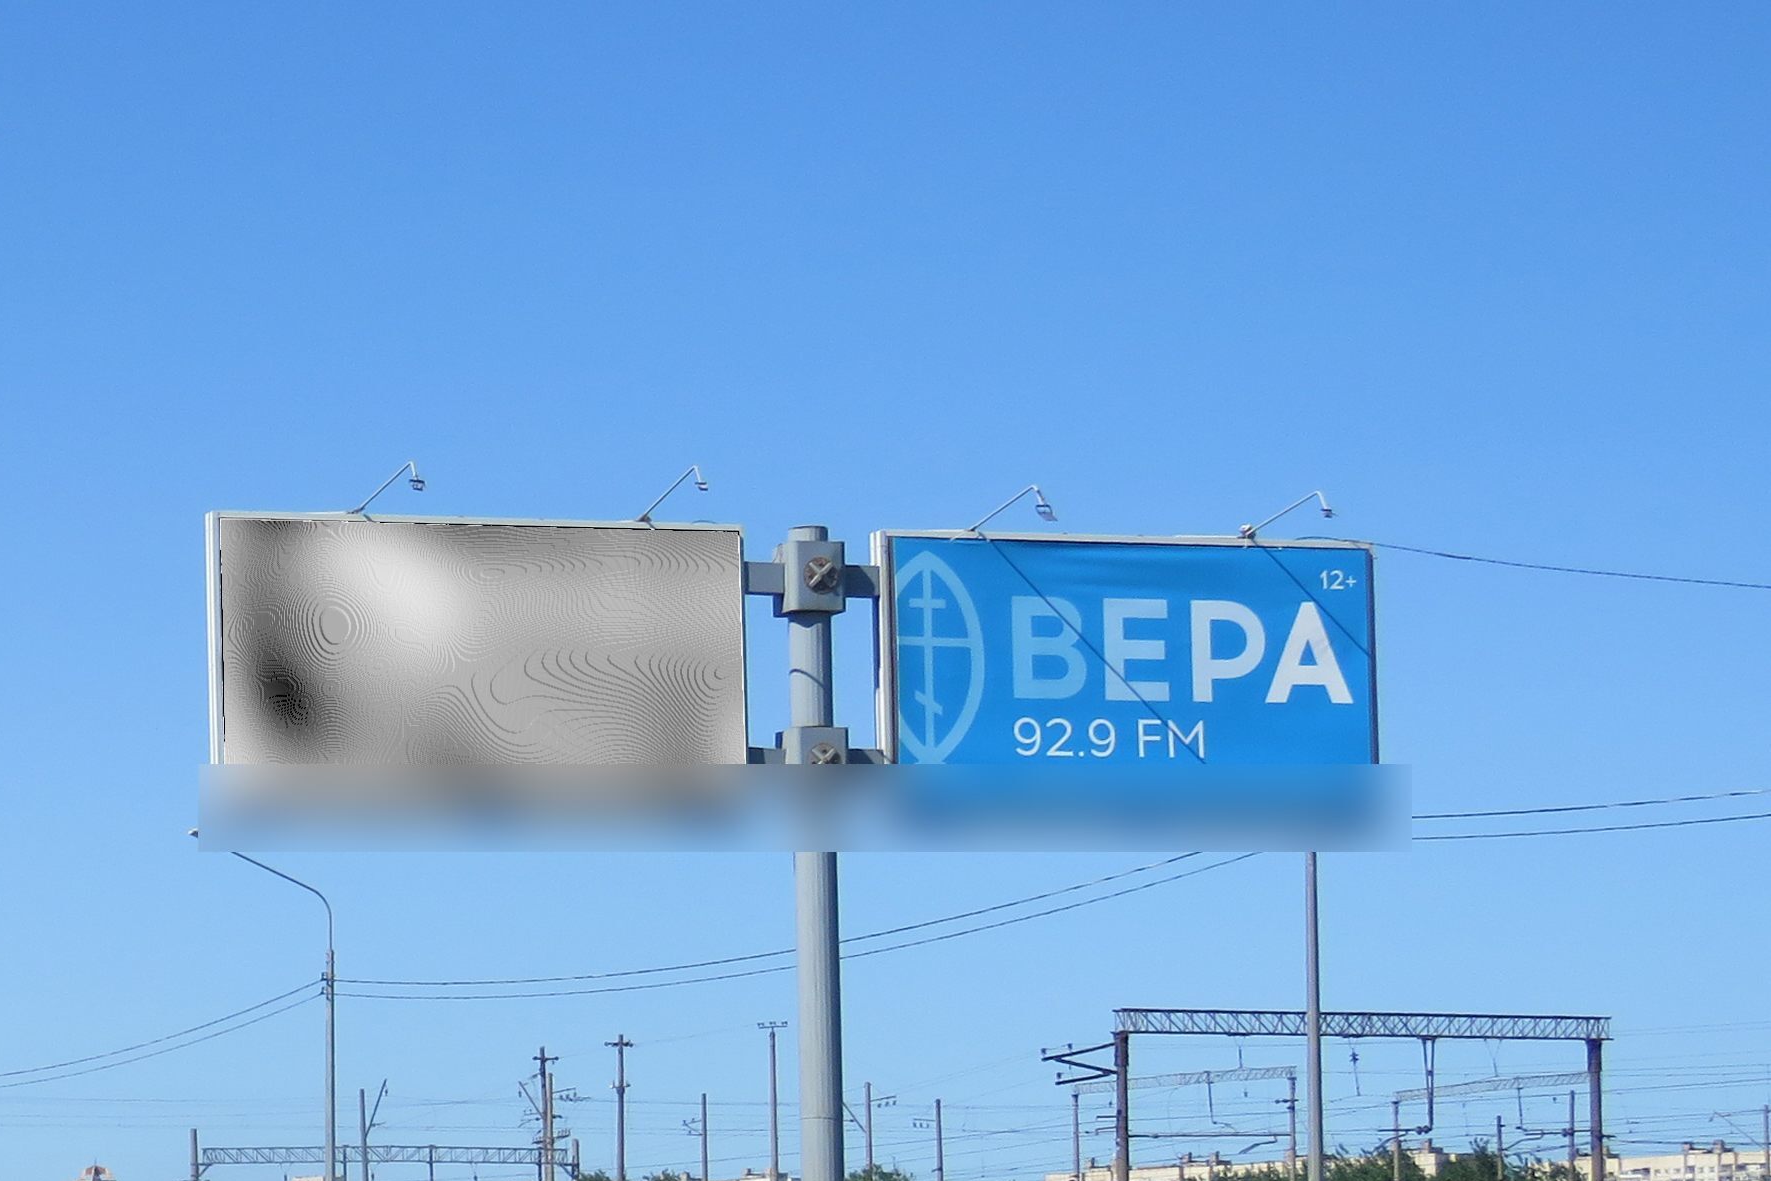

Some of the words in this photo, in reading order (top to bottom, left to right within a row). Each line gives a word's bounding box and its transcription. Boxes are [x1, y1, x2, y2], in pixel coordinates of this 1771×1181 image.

[1320, 570, 1357, 590] 12+
[1011, 596, 1354, 704] ВЕРА
[1013, 717, 1116, 758] 92.9
[1137, 719, 1205, 759] FM
